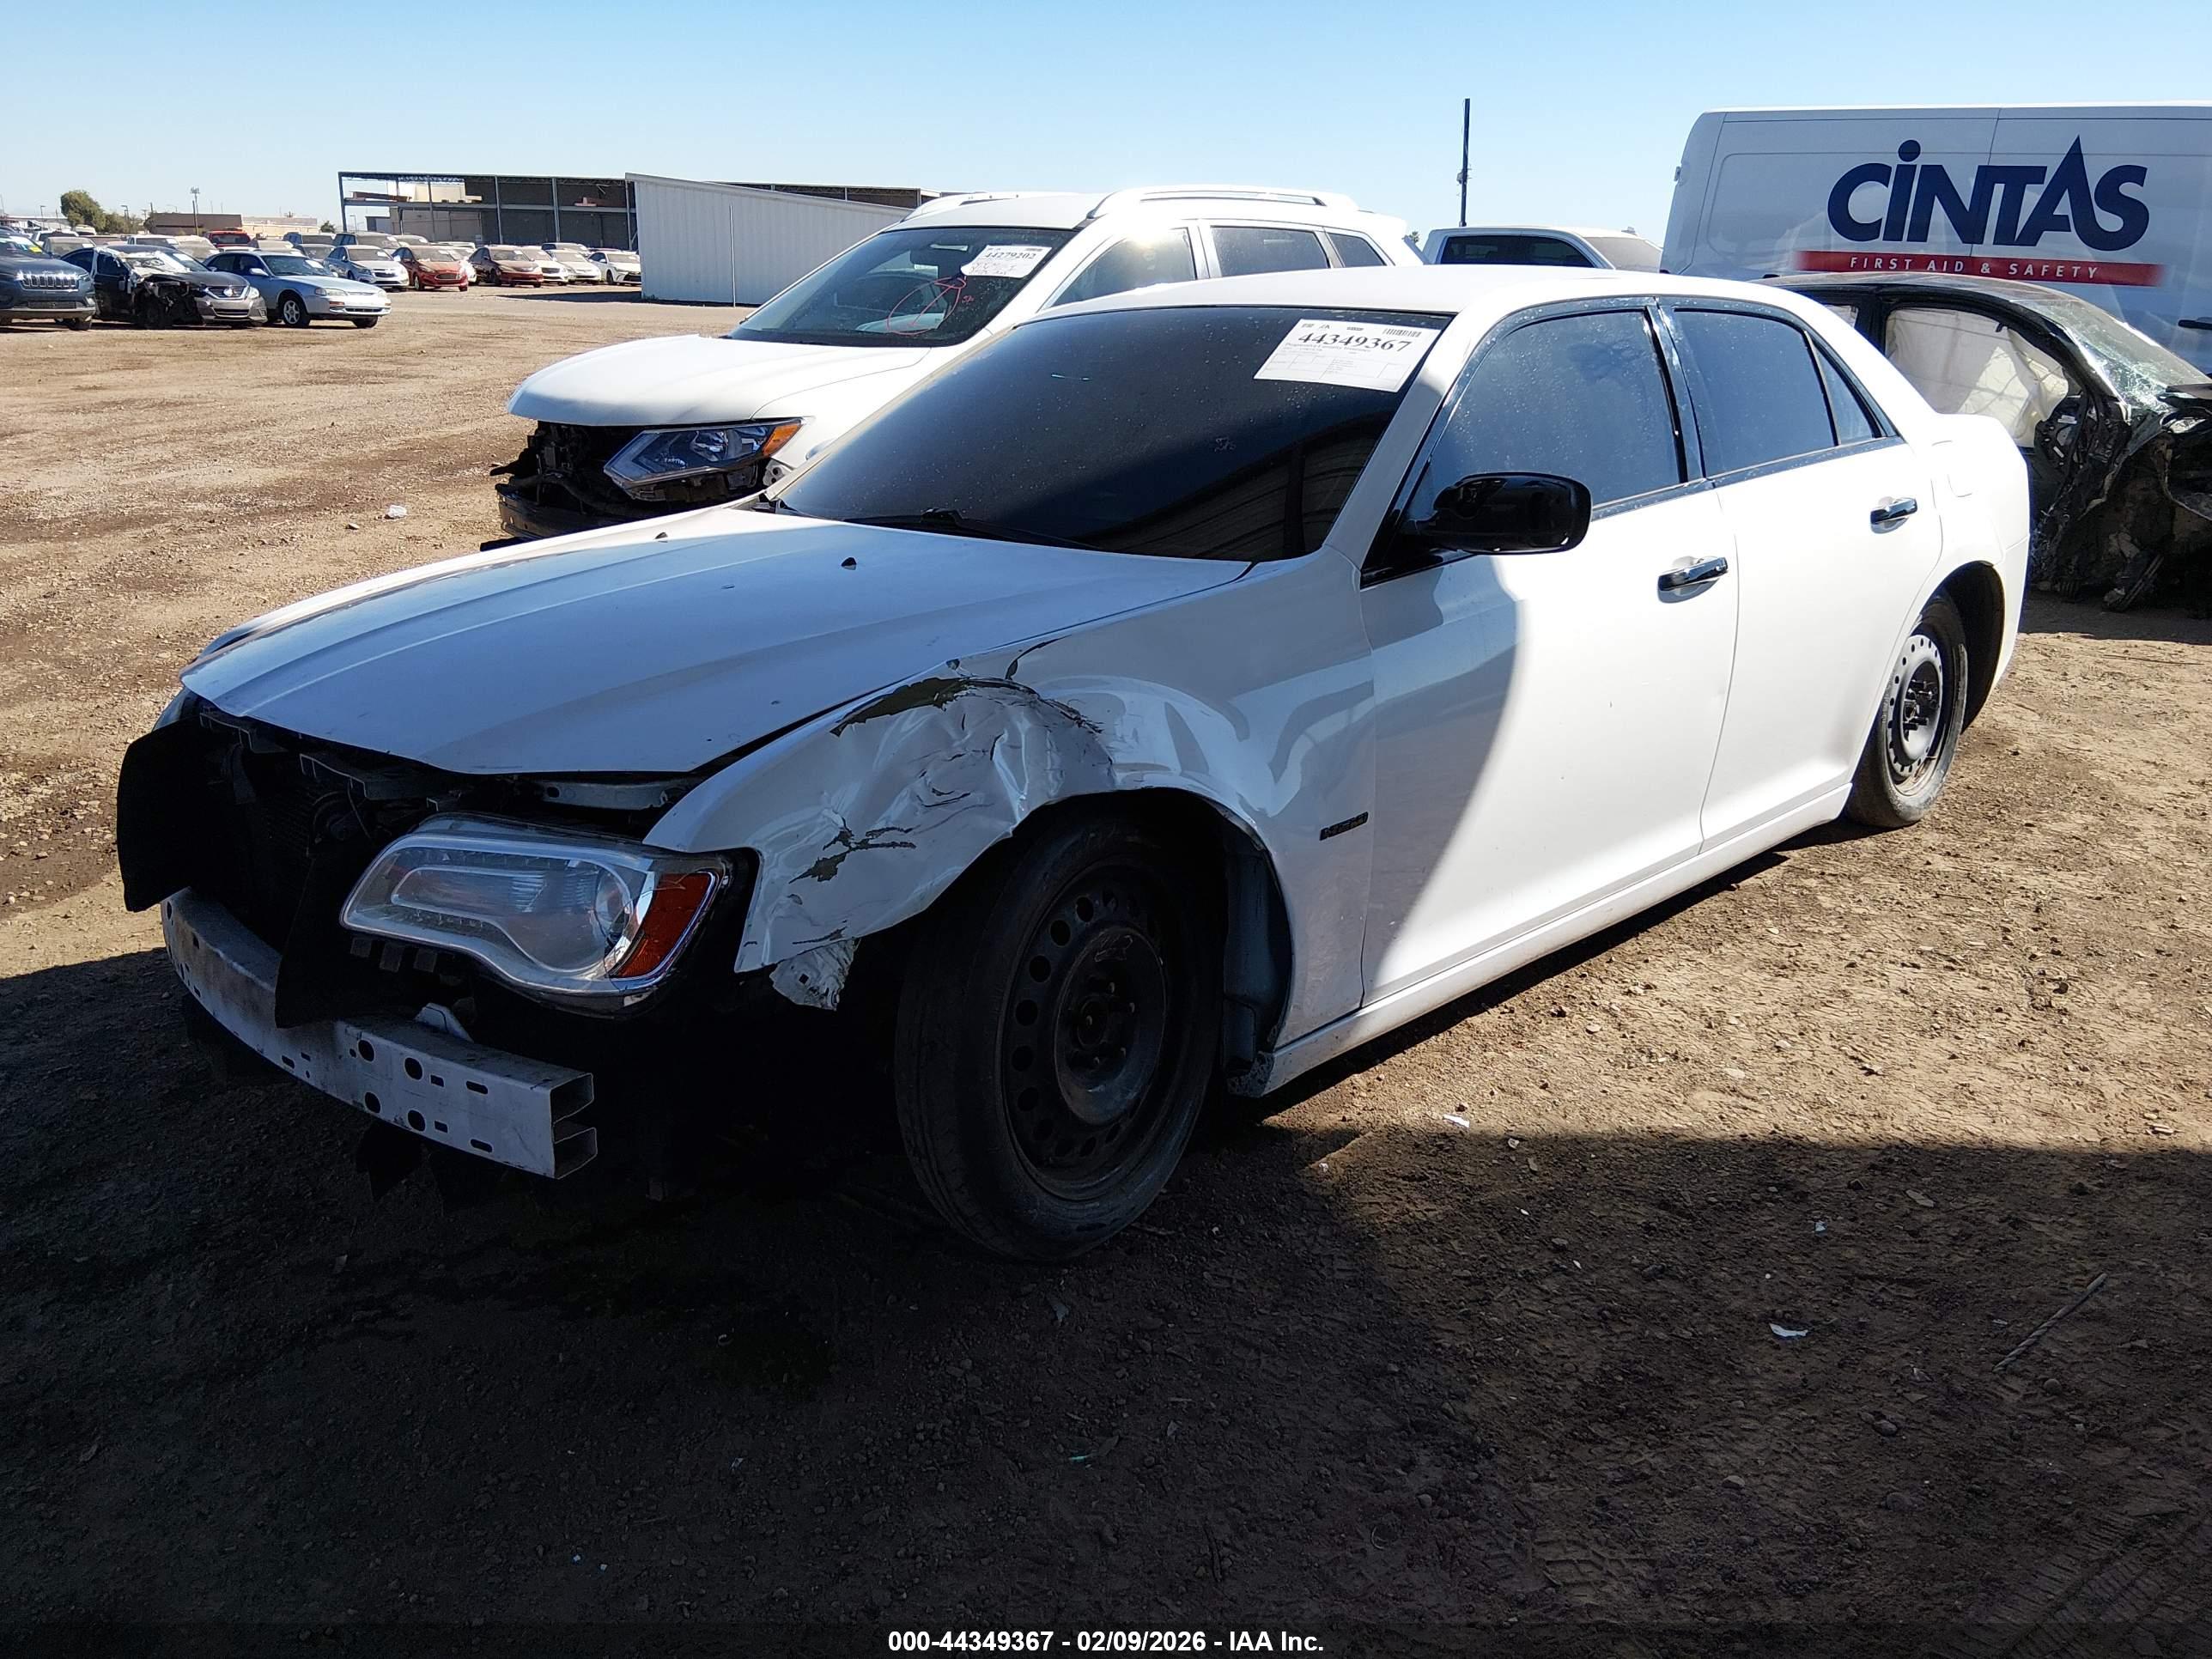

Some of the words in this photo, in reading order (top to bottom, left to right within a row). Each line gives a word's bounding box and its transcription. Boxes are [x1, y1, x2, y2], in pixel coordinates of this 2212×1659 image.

[1850, 256, 1912, 270] FIRST
[1926, 258, 1966, 272] AID
[1980, 261, 1990, 274] &
[2008, 263, 2099, 279] SAFETY
[1298, 331, 1413, 352] 44349367
